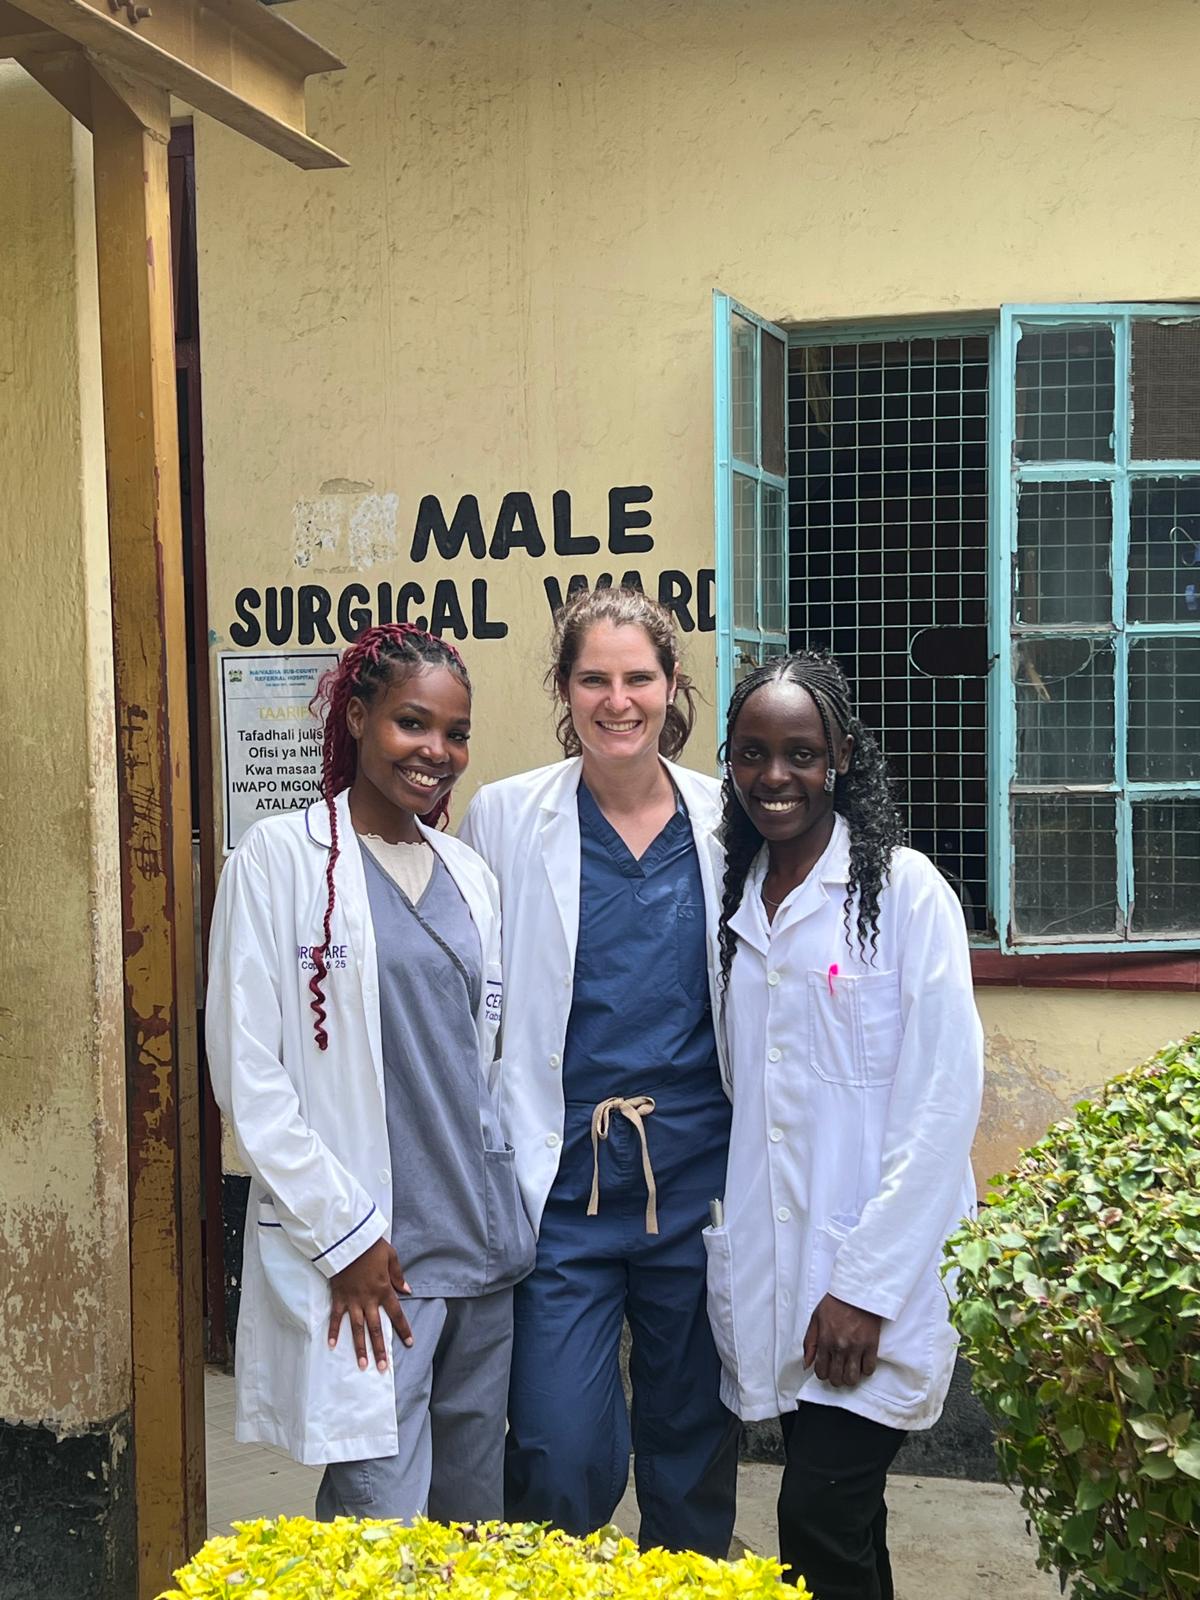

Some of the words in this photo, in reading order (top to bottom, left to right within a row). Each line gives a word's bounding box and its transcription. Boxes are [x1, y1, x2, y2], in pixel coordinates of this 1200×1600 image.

[410, 485, 654, 562] MALE
[229, 578, 508, 646] SURGICAL
[237, 729, 295, 741] Tafadhali
[248, 746, 278, 759] Ofisi
[282, 748, 297, 760] ya
[245, 764, 273, 775] Kwa
[277, 765, 317, 775] masaa
[232, 781, 277, 793] IWAPO
